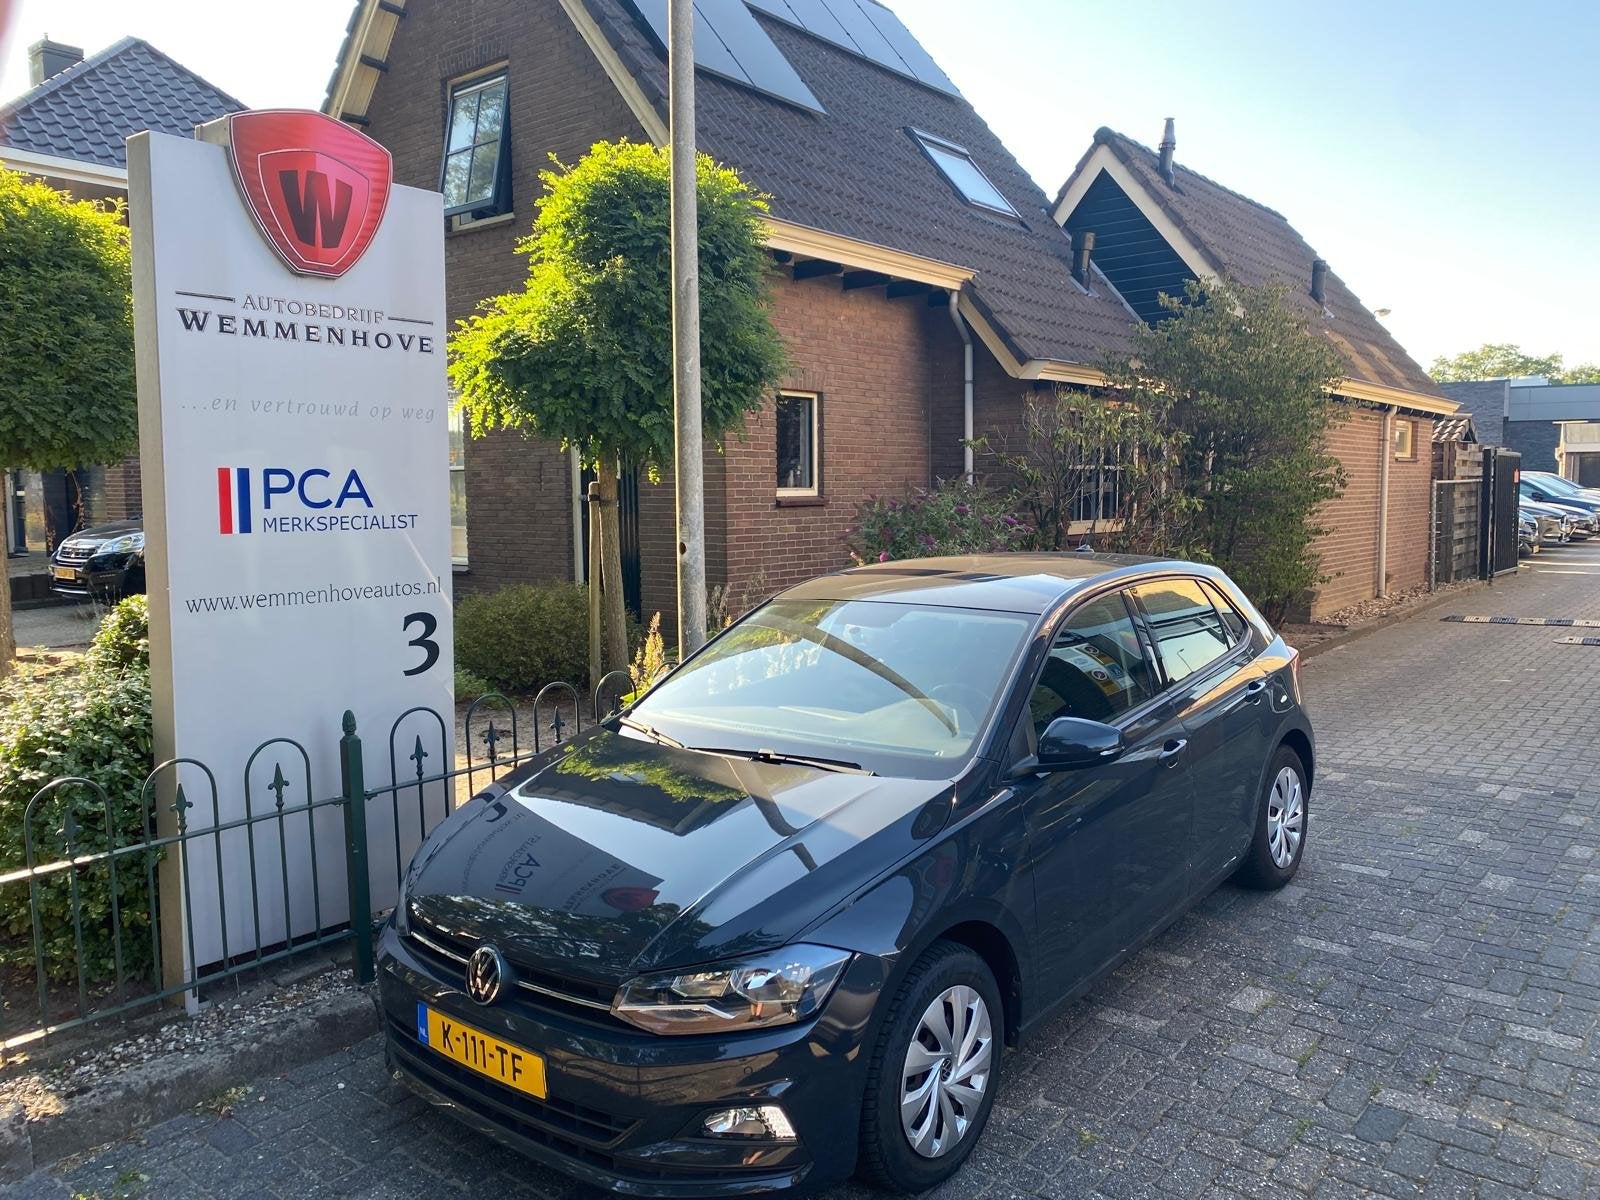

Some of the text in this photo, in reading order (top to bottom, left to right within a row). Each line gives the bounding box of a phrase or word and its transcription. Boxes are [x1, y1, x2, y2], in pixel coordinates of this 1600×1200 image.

[279, 170, 353, 249] W
[242, 294, 385, 324] AUTOBEDRIJF
[177, 308, 434, 355] WEMMENHOVE
[251, 398, 359, 417] vertrouwd
[370, 405, 392, 420] op
[402, 408, 435, 423] weg
[263, 468, 374, 509] PCA
[263, 514, 419, 533] MERKSPECIALIST
[185, 576, 442, 614] www.wemmenhoveautos.nl
[402, 611, 440, 677] 3
[441, 1021, 523, 1082] K-111-TF
